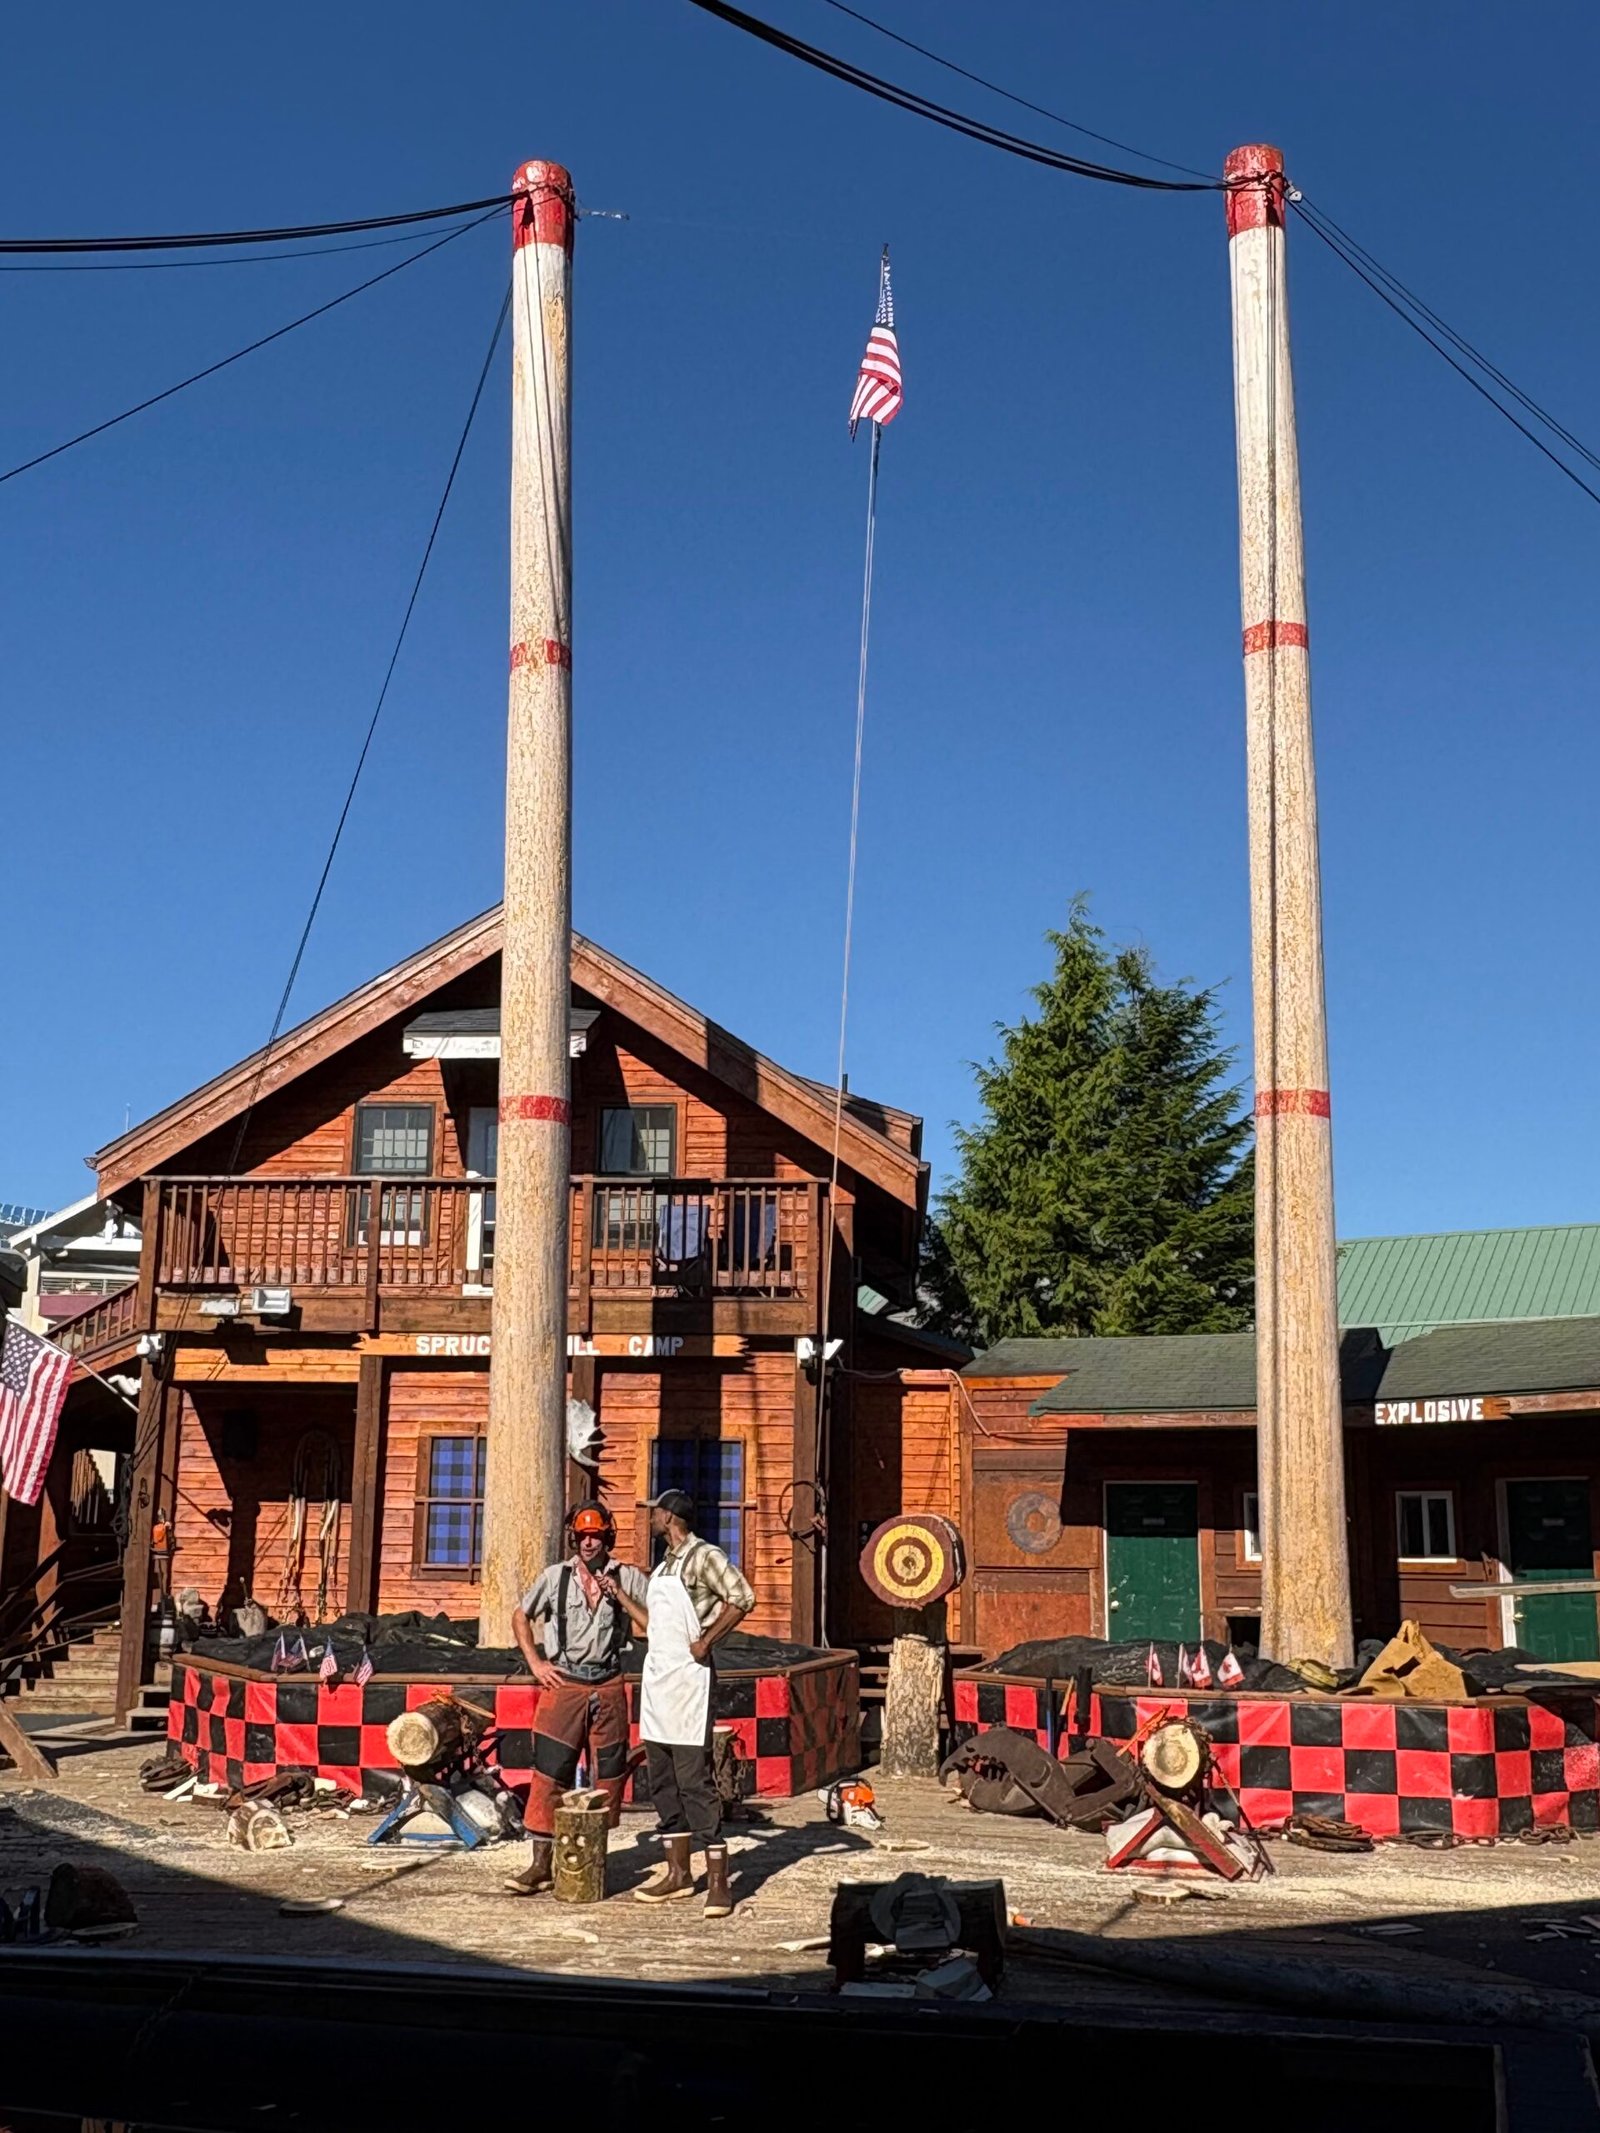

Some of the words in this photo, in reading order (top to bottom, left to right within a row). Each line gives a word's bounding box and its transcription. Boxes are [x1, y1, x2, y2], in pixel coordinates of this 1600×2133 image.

[416, 1335, 491, 1356] SPRUC
[566, 1335, 601, 1356] ILL
[628, 1335, 684, 1356] CAMP
[1374, 1398, 1484, 1425] EXPLOSIVE
